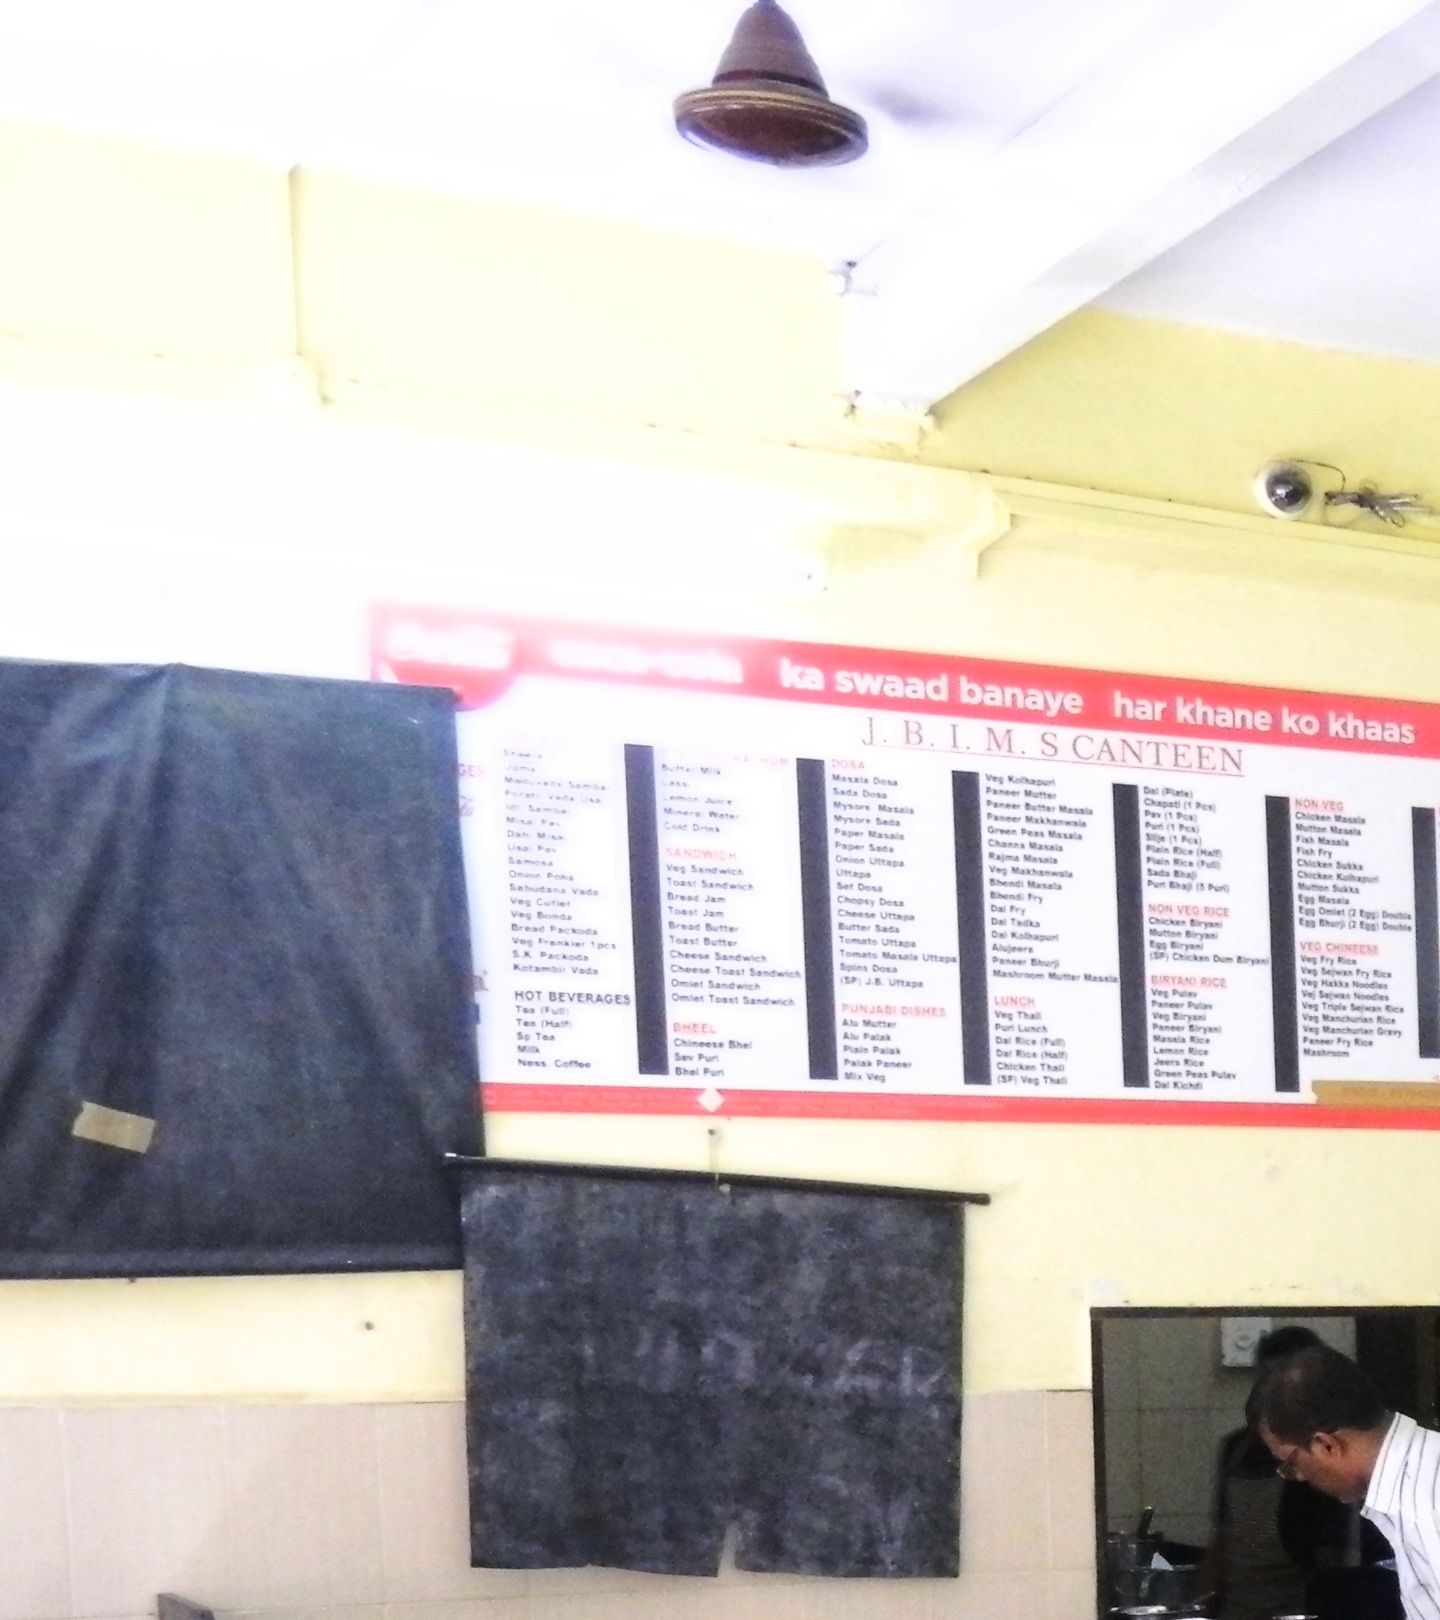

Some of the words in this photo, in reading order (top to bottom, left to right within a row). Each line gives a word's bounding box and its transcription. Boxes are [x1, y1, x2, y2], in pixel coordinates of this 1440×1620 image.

[780, 657, 825, 691] ka
[834, 667, 949, 702] swaad
[959, 675, 1084, 718] banaye
[1113, 691, 1167, 723] har
[1175, 696, 1272, 732] khane
[1281, 706, 1320, 736] ko
[1328, 710, 1416, 746] khaas
[1072, 734, 1245, 773] CANTEEN
